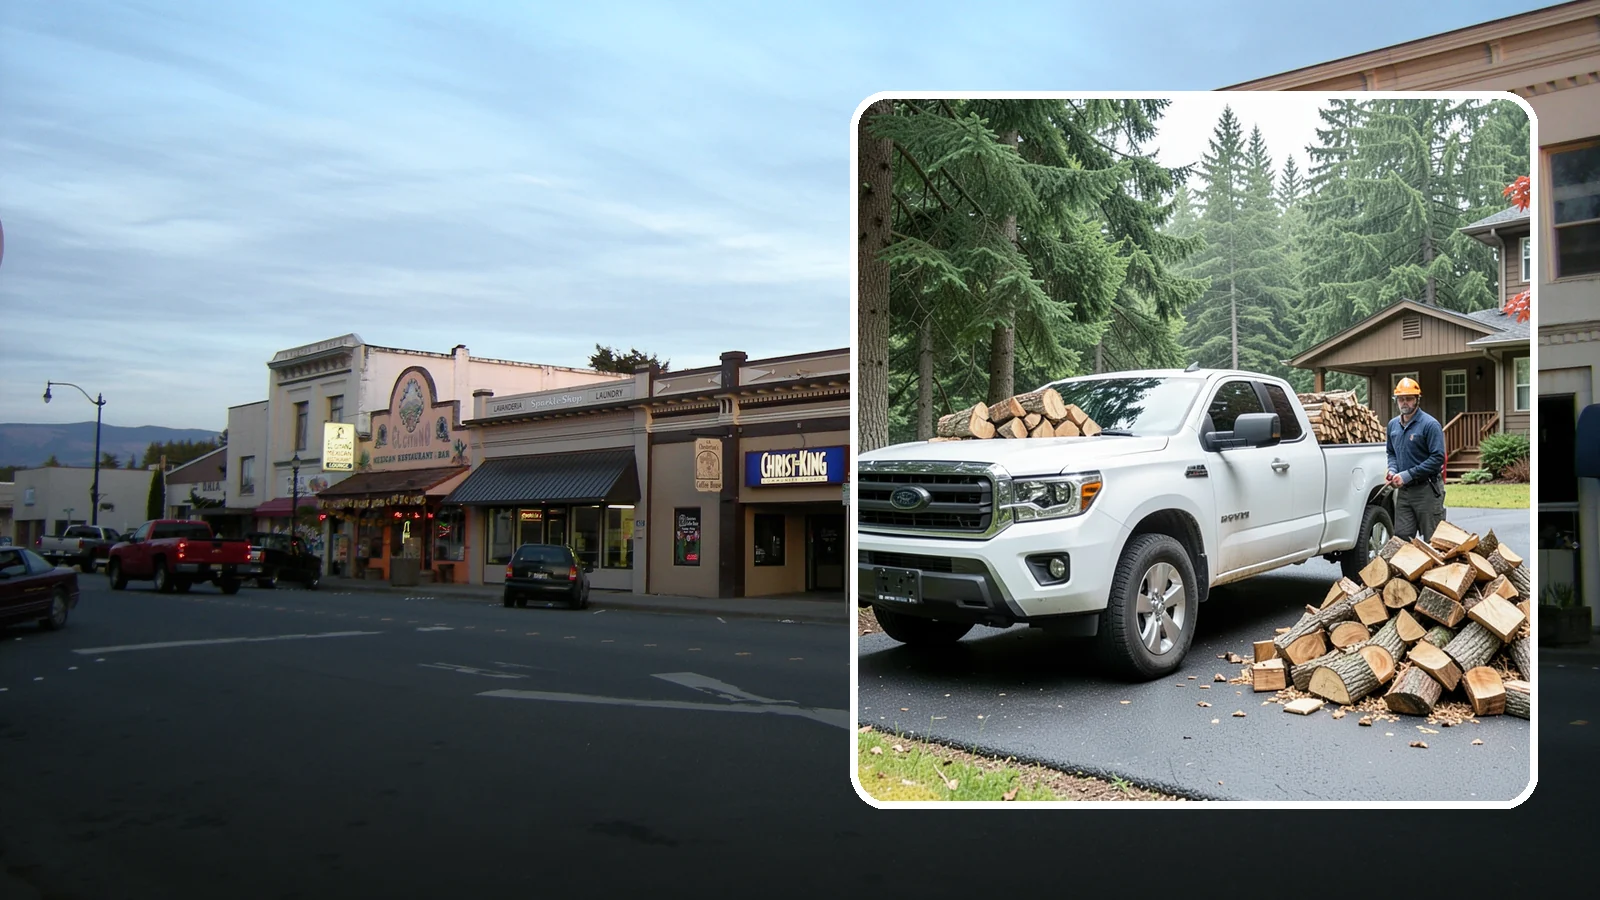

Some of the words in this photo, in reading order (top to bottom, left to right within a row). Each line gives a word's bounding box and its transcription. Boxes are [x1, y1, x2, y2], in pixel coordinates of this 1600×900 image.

[530, 396, 561, 409] Sparkle
[562, 394, 582, 404] Shop
[595, 389, 623, 400] LAUNDRY
[493, 402, 522, 413] LAVANDERIA
[373, 454, 396, 464] MEXICAN
[397, 451, 434, 462] RESTAURANT
[437, 450, 450, 459] BAR
[760, 452, 797, 478] CHRIST
[799, 450, 827, 476] KING
